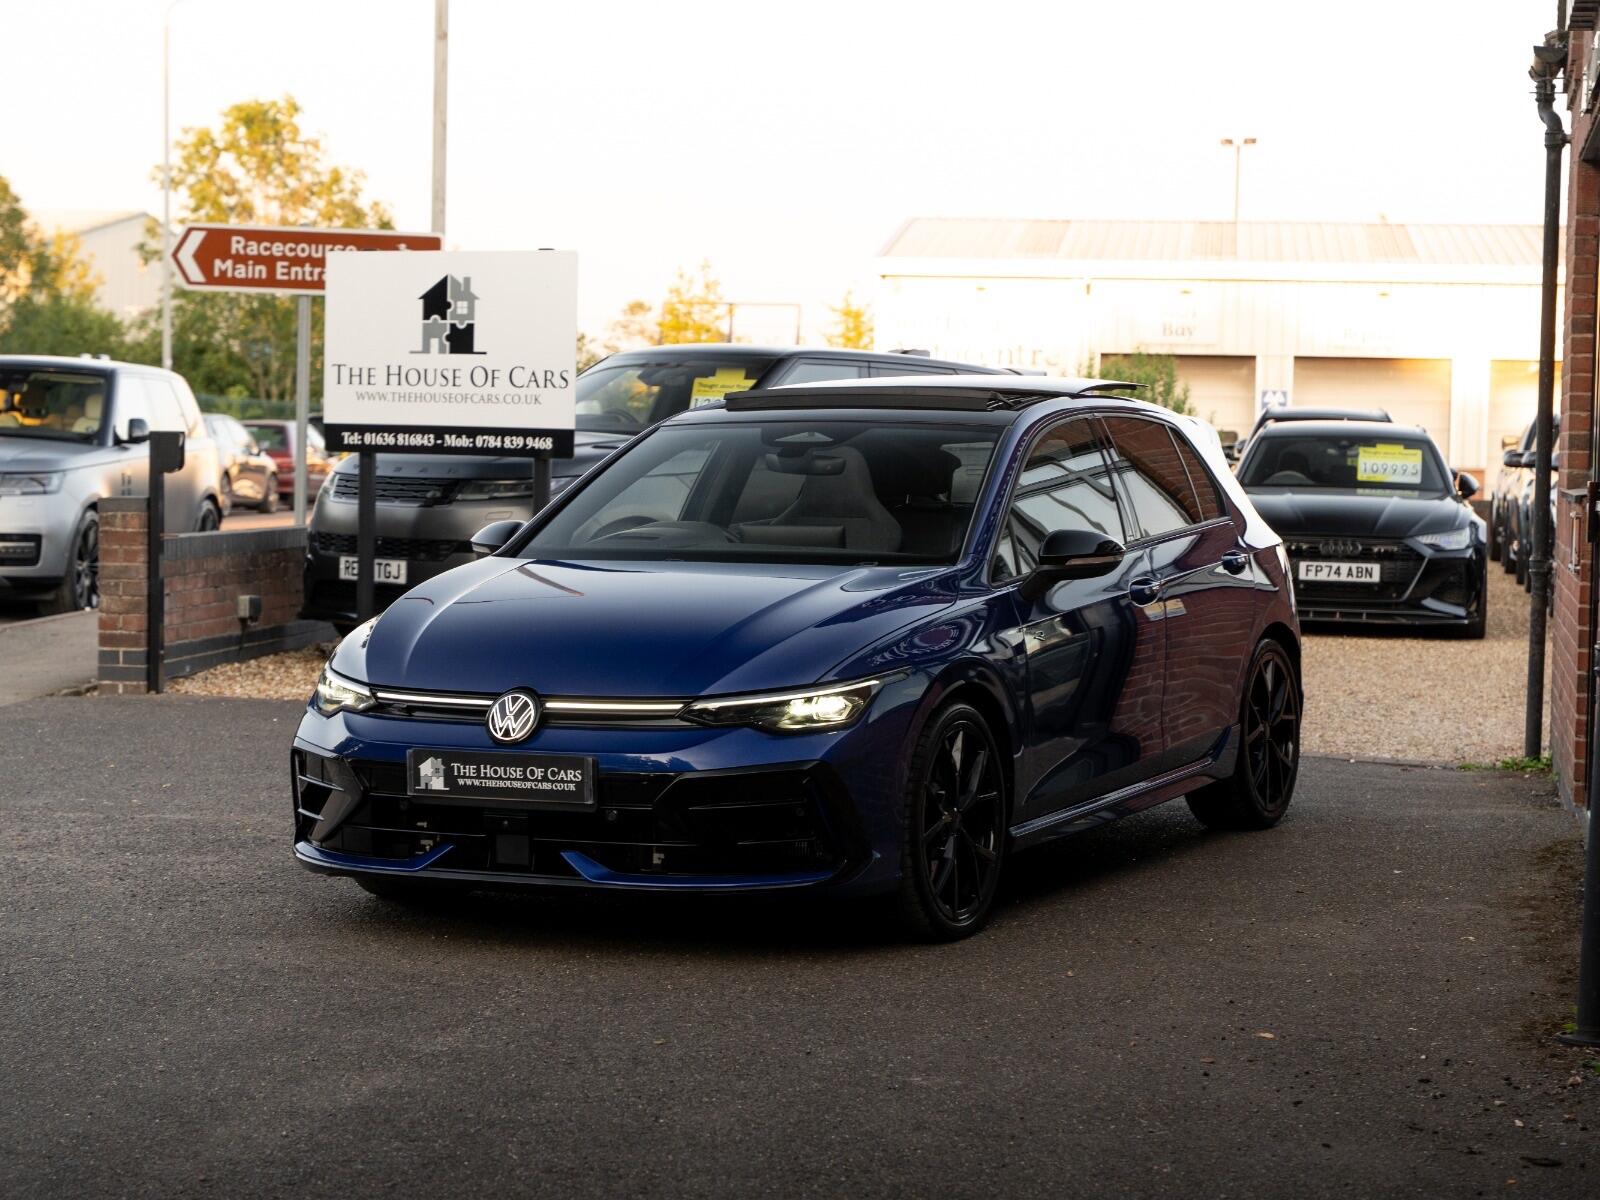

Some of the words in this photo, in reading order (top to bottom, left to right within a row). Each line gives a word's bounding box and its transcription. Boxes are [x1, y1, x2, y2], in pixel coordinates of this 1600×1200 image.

[213, 258, 267, 279] Main
[331, 363, 376, 386] THE
[386, 364, 462, 387] HOUSE
[470, 365, 501, 388] OF
[509, 366, 569, 389] CARS
[341, 431, 362, 445] Tel:
[363, 432, 396, 446] 01636
[396, 433, 435, 447] 816843
[443, 434, 474, 448] Mob:
[475, 435, 501, 449] 0784
[503, 436, 524, 449] 839
[525, 437, 553, 450] 9468
[376, 562, 400, 579] TGJ
[1305, 564, 1341, 577] FP74
[1346, 566, 1374, 579] ABN
[451, 763, 477, 776] THE
[480, 764, 524, 779] HOUSE
[527, 766, 545, 780] OF
[547, 767, 582, 782] CARS
